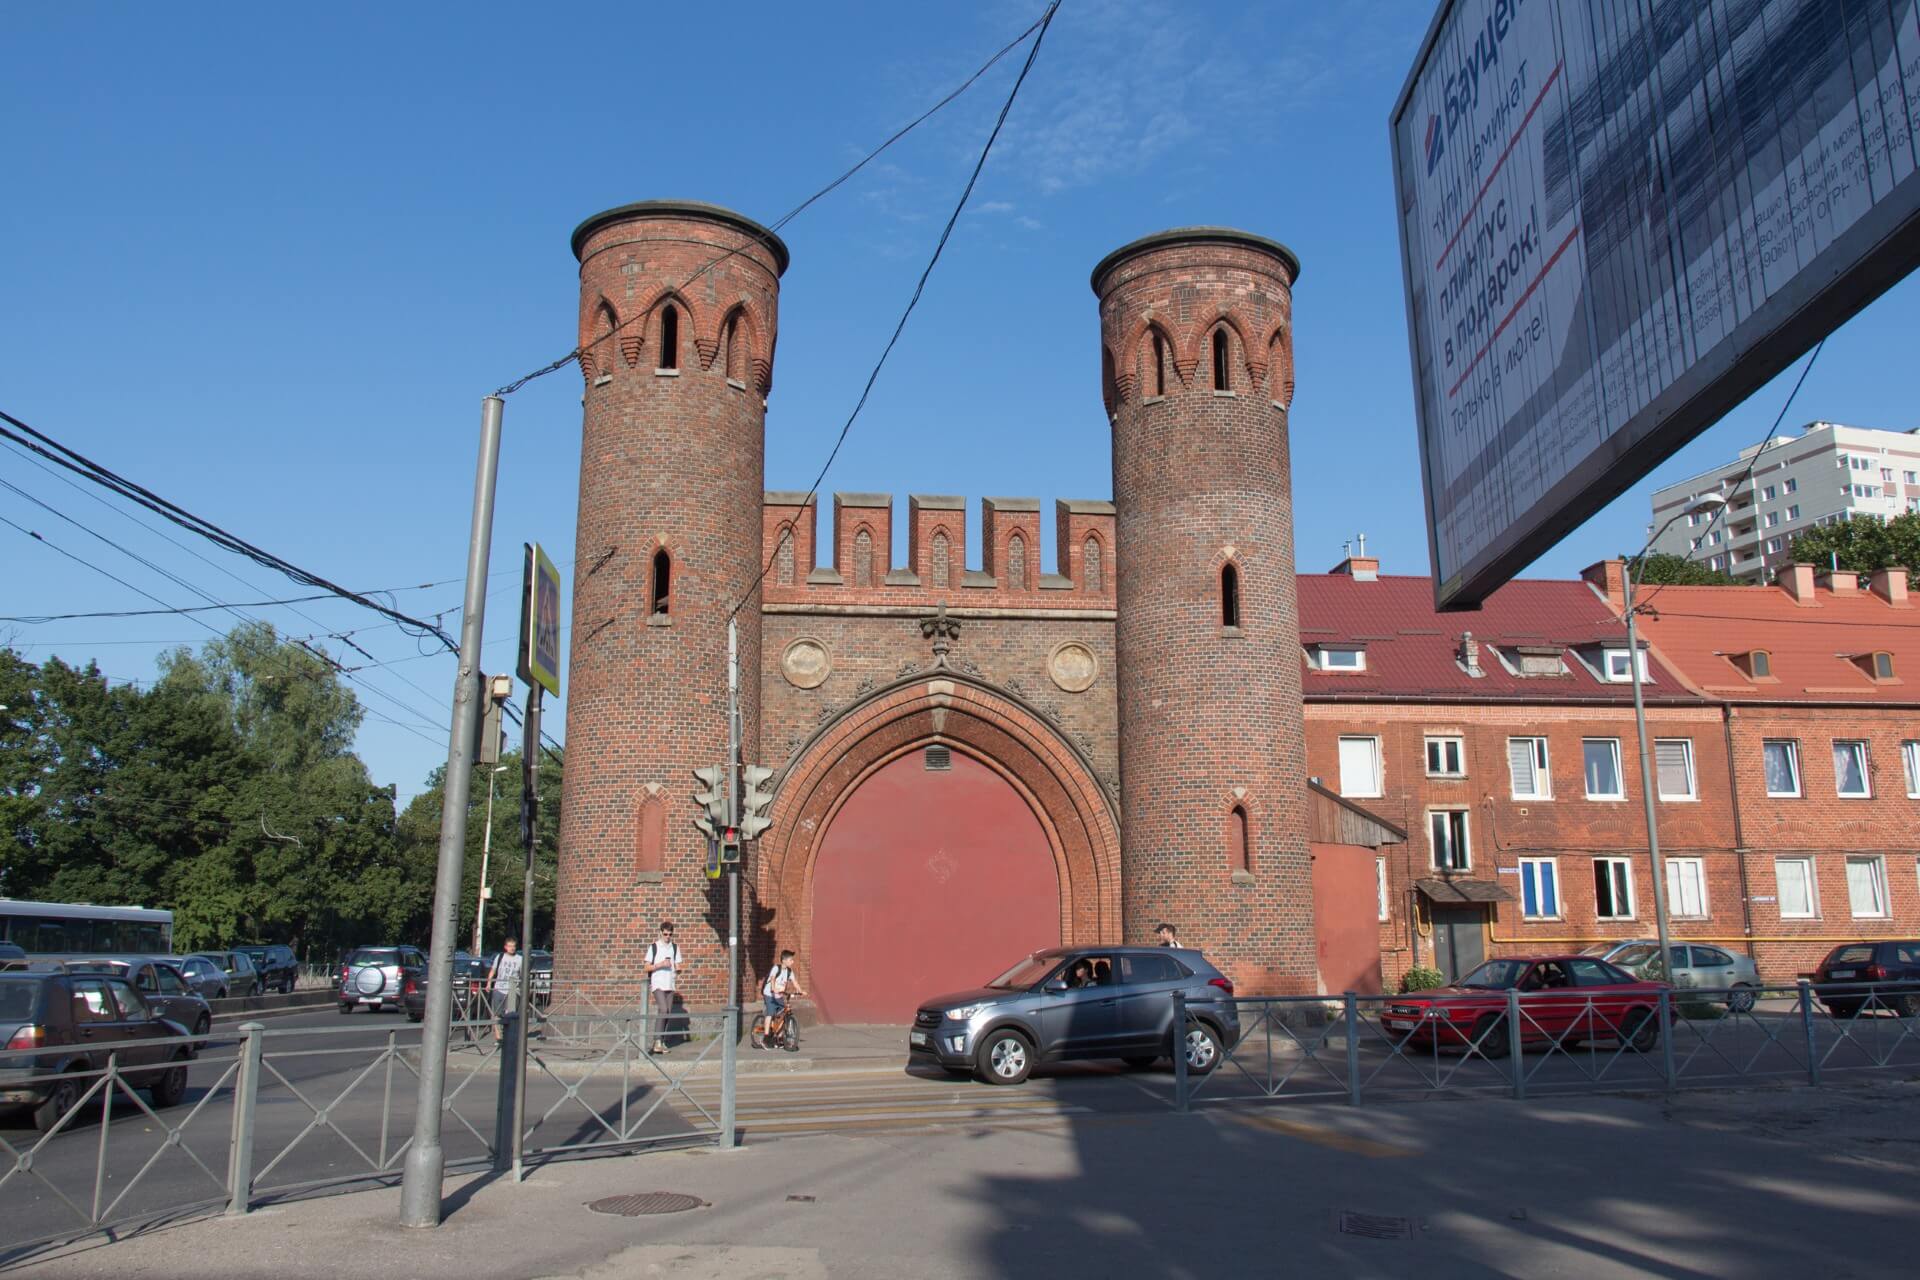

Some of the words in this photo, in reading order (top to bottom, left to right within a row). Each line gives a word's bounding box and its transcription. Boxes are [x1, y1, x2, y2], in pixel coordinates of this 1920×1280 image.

[1440, 198, 1507, 320] плинтус
[1445, 337, 1454, 368] в
[1457, 203, 1538, 350] подарок!
[1504, 301, 1545, 374] июле!
